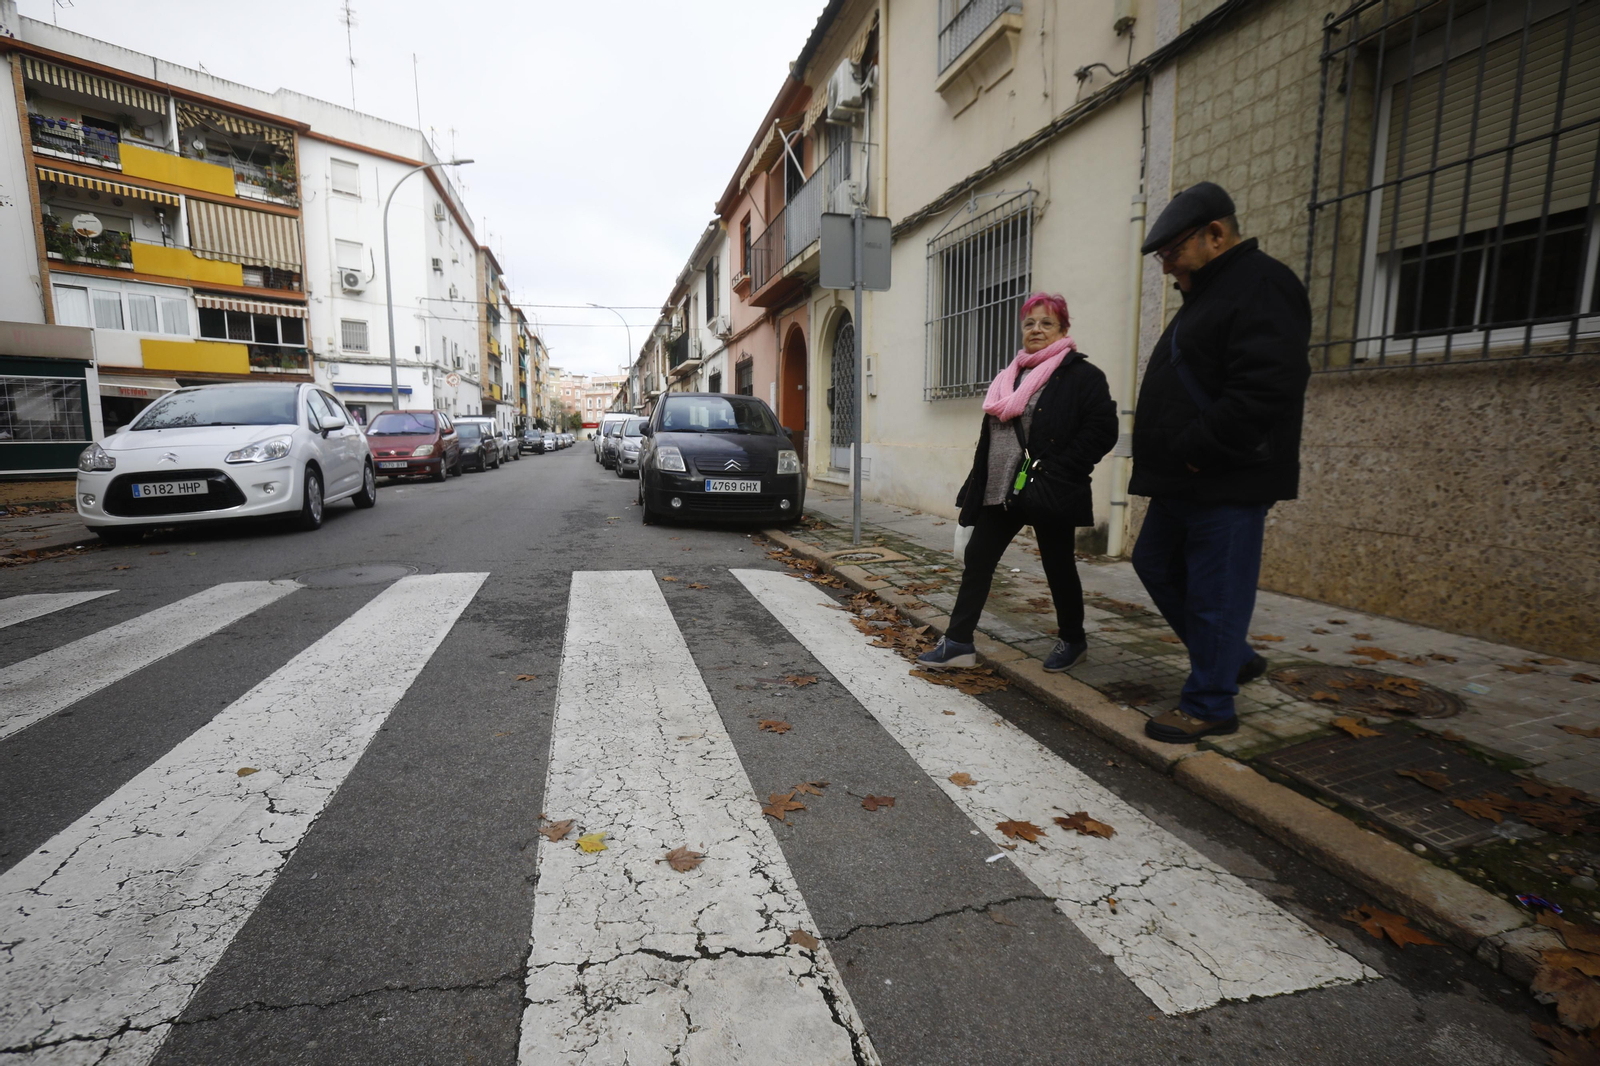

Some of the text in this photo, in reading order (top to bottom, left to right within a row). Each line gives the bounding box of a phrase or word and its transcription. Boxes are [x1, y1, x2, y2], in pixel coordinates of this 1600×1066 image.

[119, 387, 148, 396] VICTORIA
[143, 482, 201, 495] 6182 HHP
[712, 481, 758, 491] 4769 GHX
